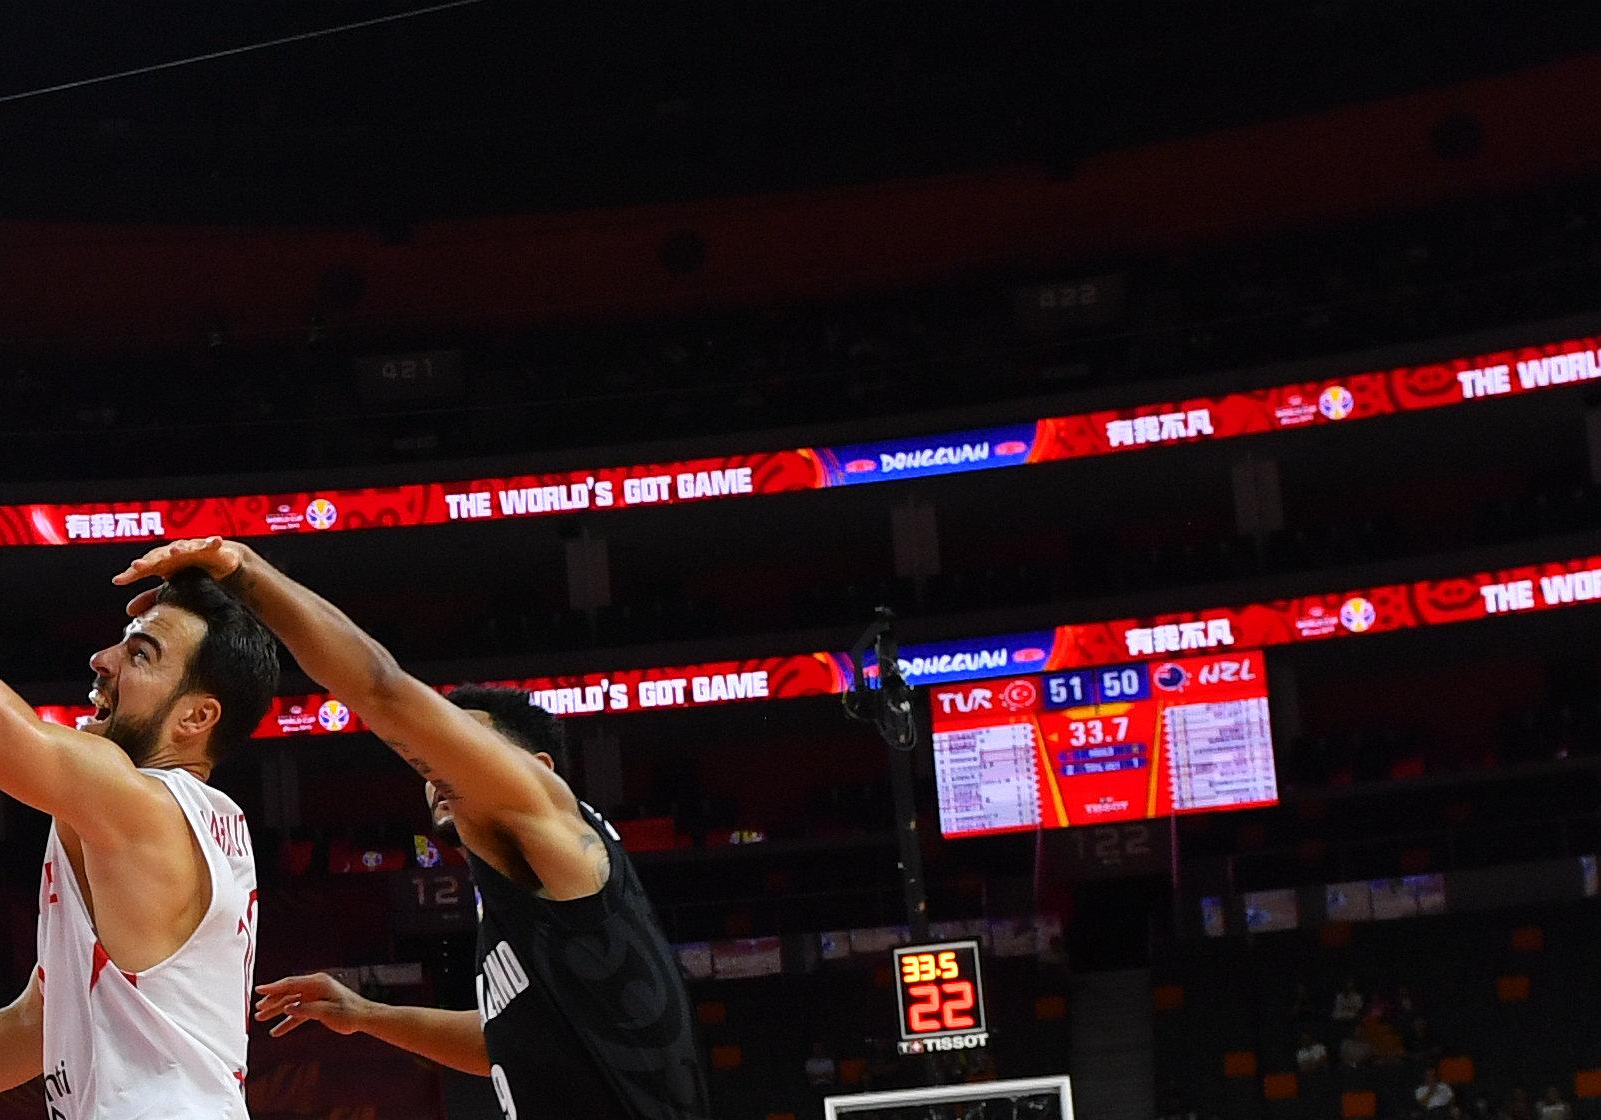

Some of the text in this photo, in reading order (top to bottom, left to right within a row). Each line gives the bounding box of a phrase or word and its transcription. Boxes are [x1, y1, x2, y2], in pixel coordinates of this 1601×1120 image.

[1457, 366, 1511, 398] THE
[880, 442, 990, 473] DONGGUAN
[445, 467, 753, 519] THE WORLD'S GOT GAME
[1480, 580, 1535, 613] THE
[1103, 670, 1139, 697] 50
[1198, 660, 1255, 685] NZL
[638, 678, 687, 708] GOT
[691, 670, 769, 703] GAME
[1049, 676, 1082, 703] 51
[1069, 717, 1130, 747] 33.7
[408, 876, 459, 906] 12
[901, 951, 959, 983] 33.5
[908, 981, 976, 1033] 22
[923, 1032, 989, 1053] TISSOT
